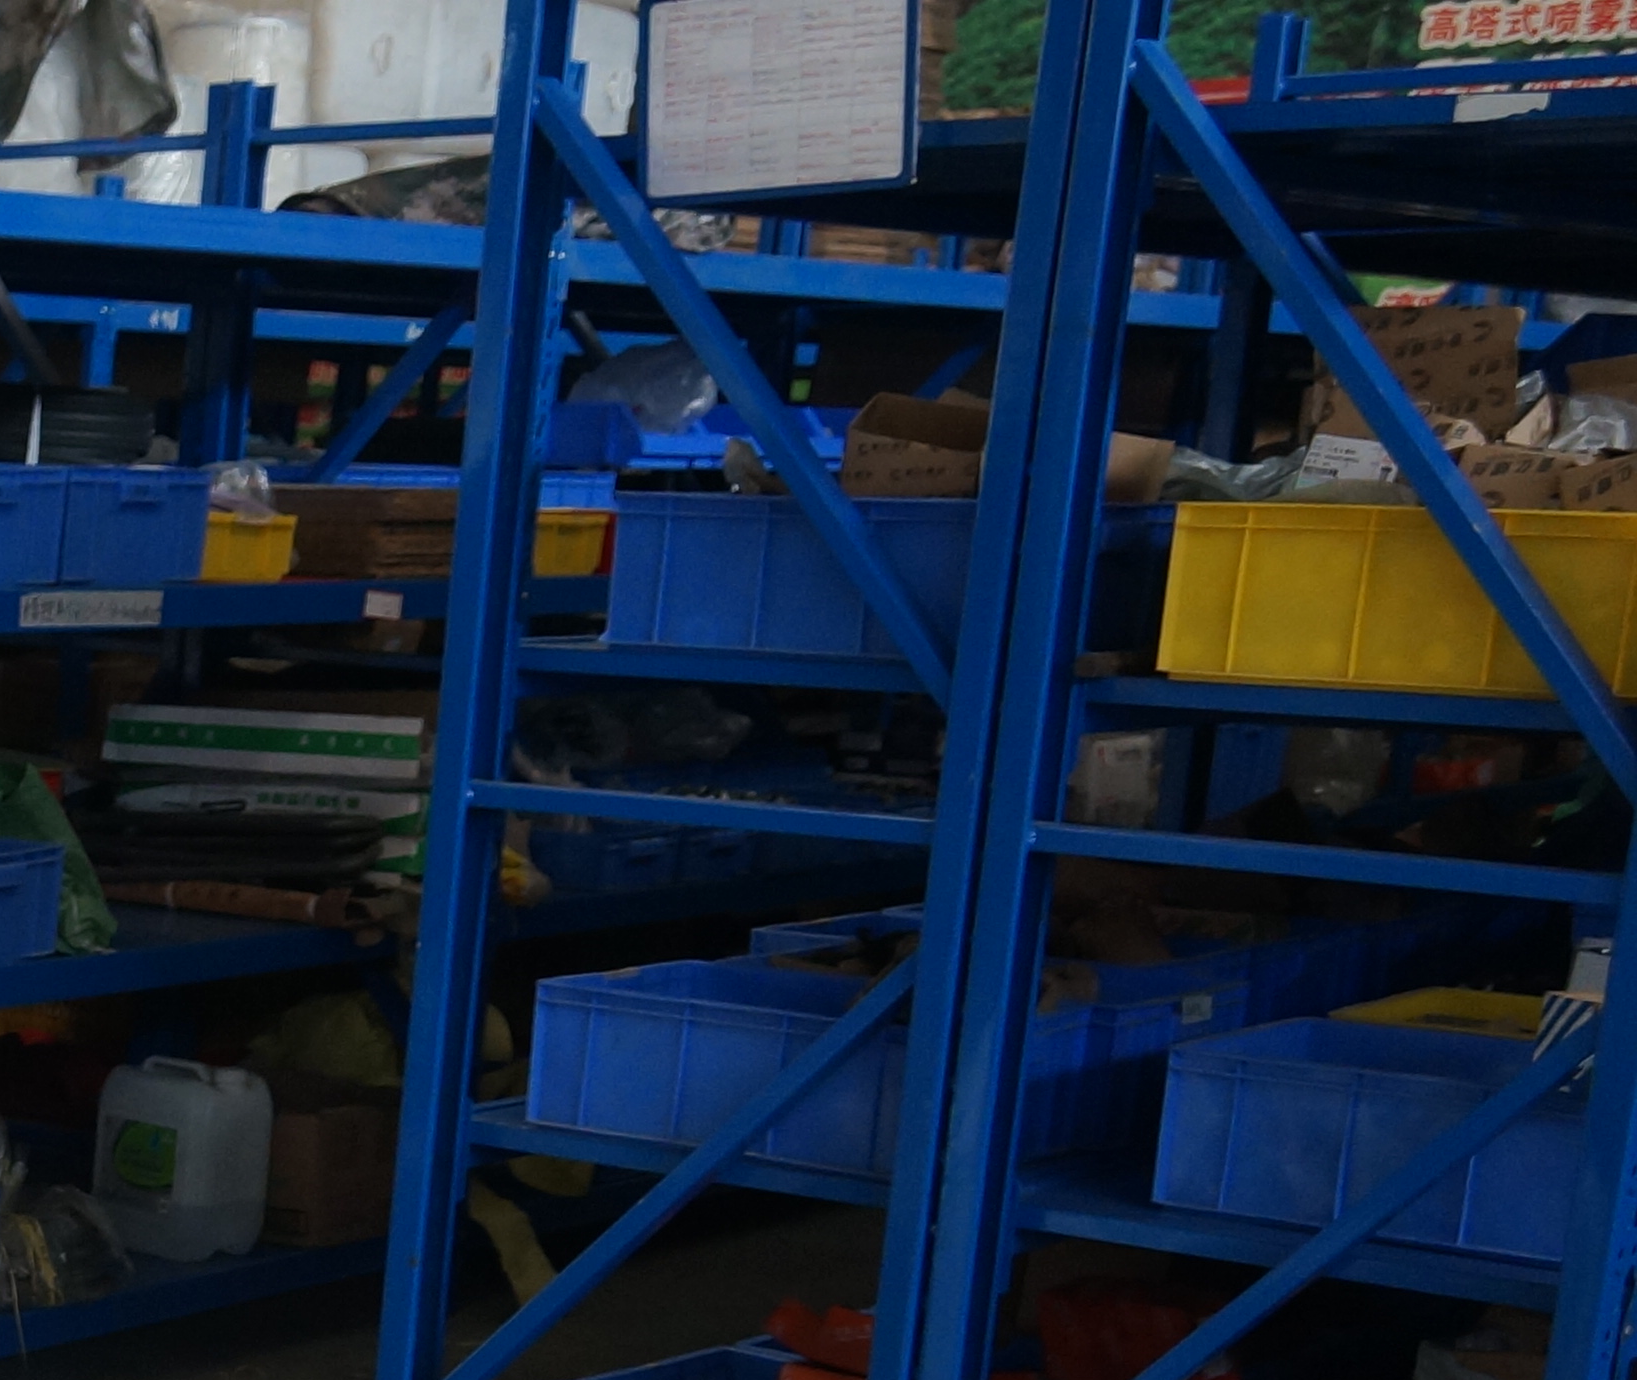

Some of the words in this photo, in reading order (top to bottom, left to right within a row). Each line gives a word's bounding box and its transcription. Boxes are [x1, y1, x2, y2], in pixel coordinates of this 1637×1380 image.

[1425, 0, 1637, 43] 高塔式喷雾
